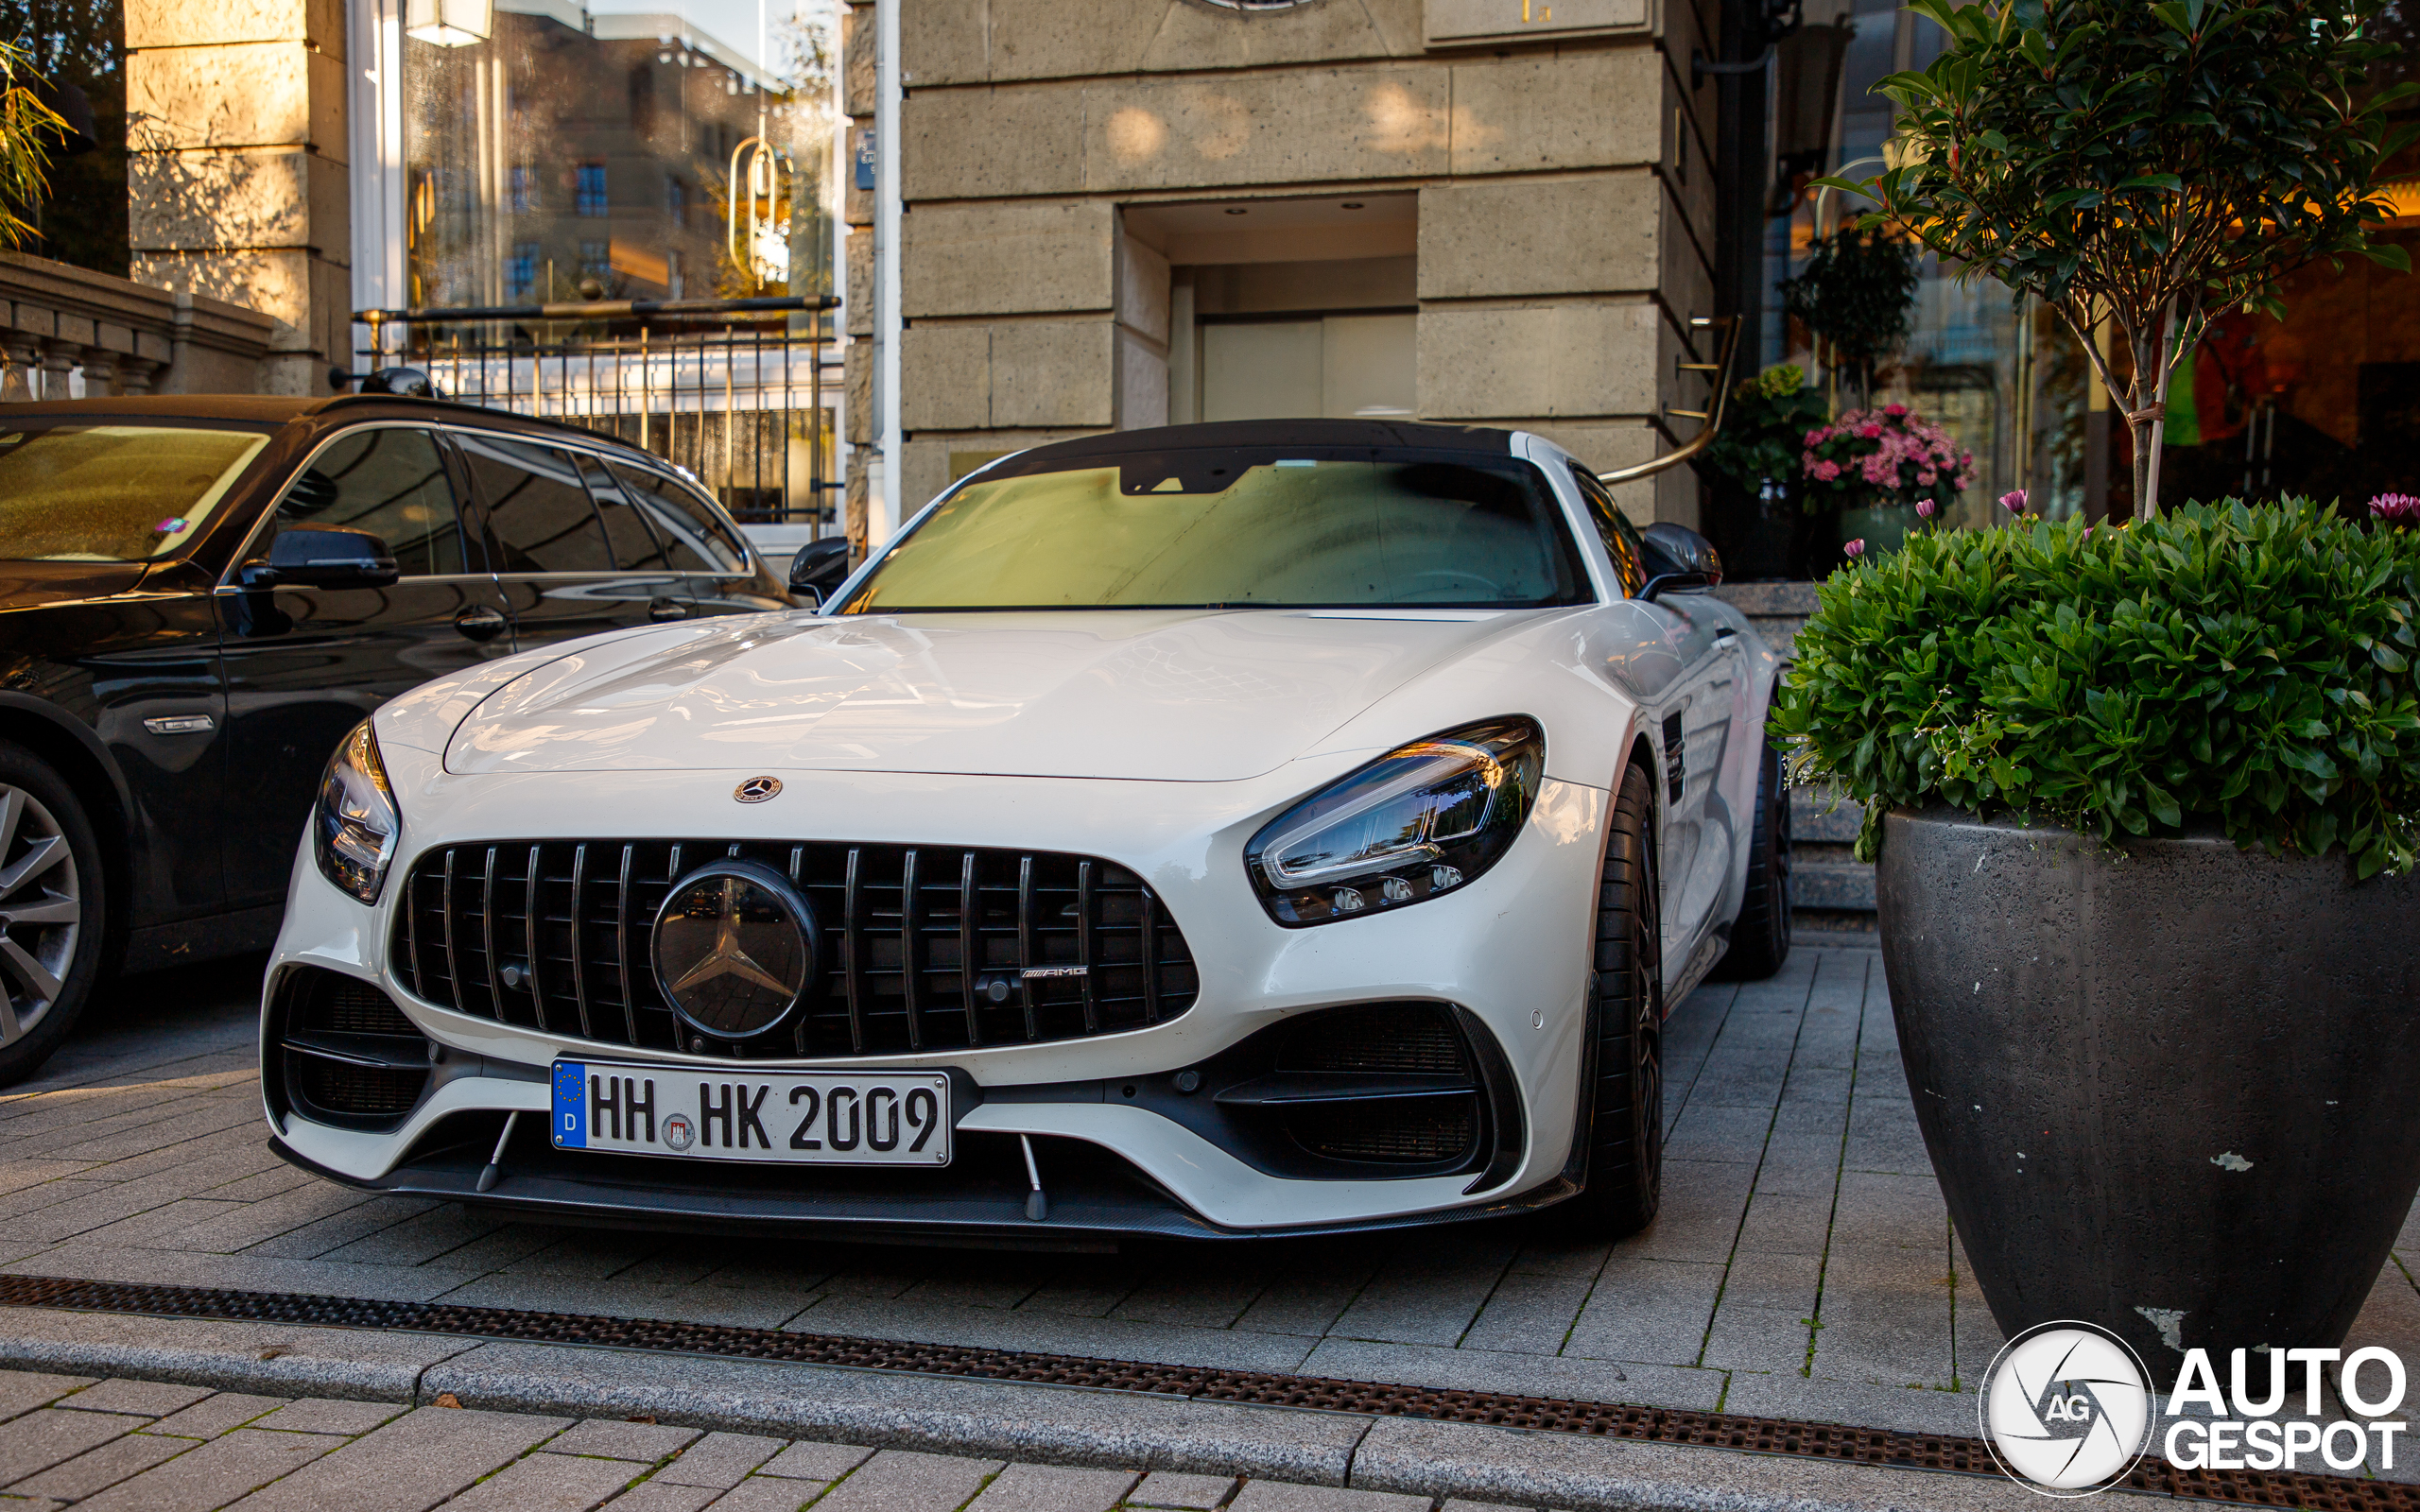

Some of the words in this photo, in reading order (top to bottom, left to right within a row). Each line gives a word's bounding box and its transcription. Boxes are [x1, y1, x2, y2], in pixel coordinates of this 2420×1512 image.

[1042, 967, 1087, 977] AMG
[564, 1113, 577, 1131] D
[590, 1074, 656, 1143] HH
[700, 1082, 771, 1149] HK
[787, 1085, 939, 1153] 2009
